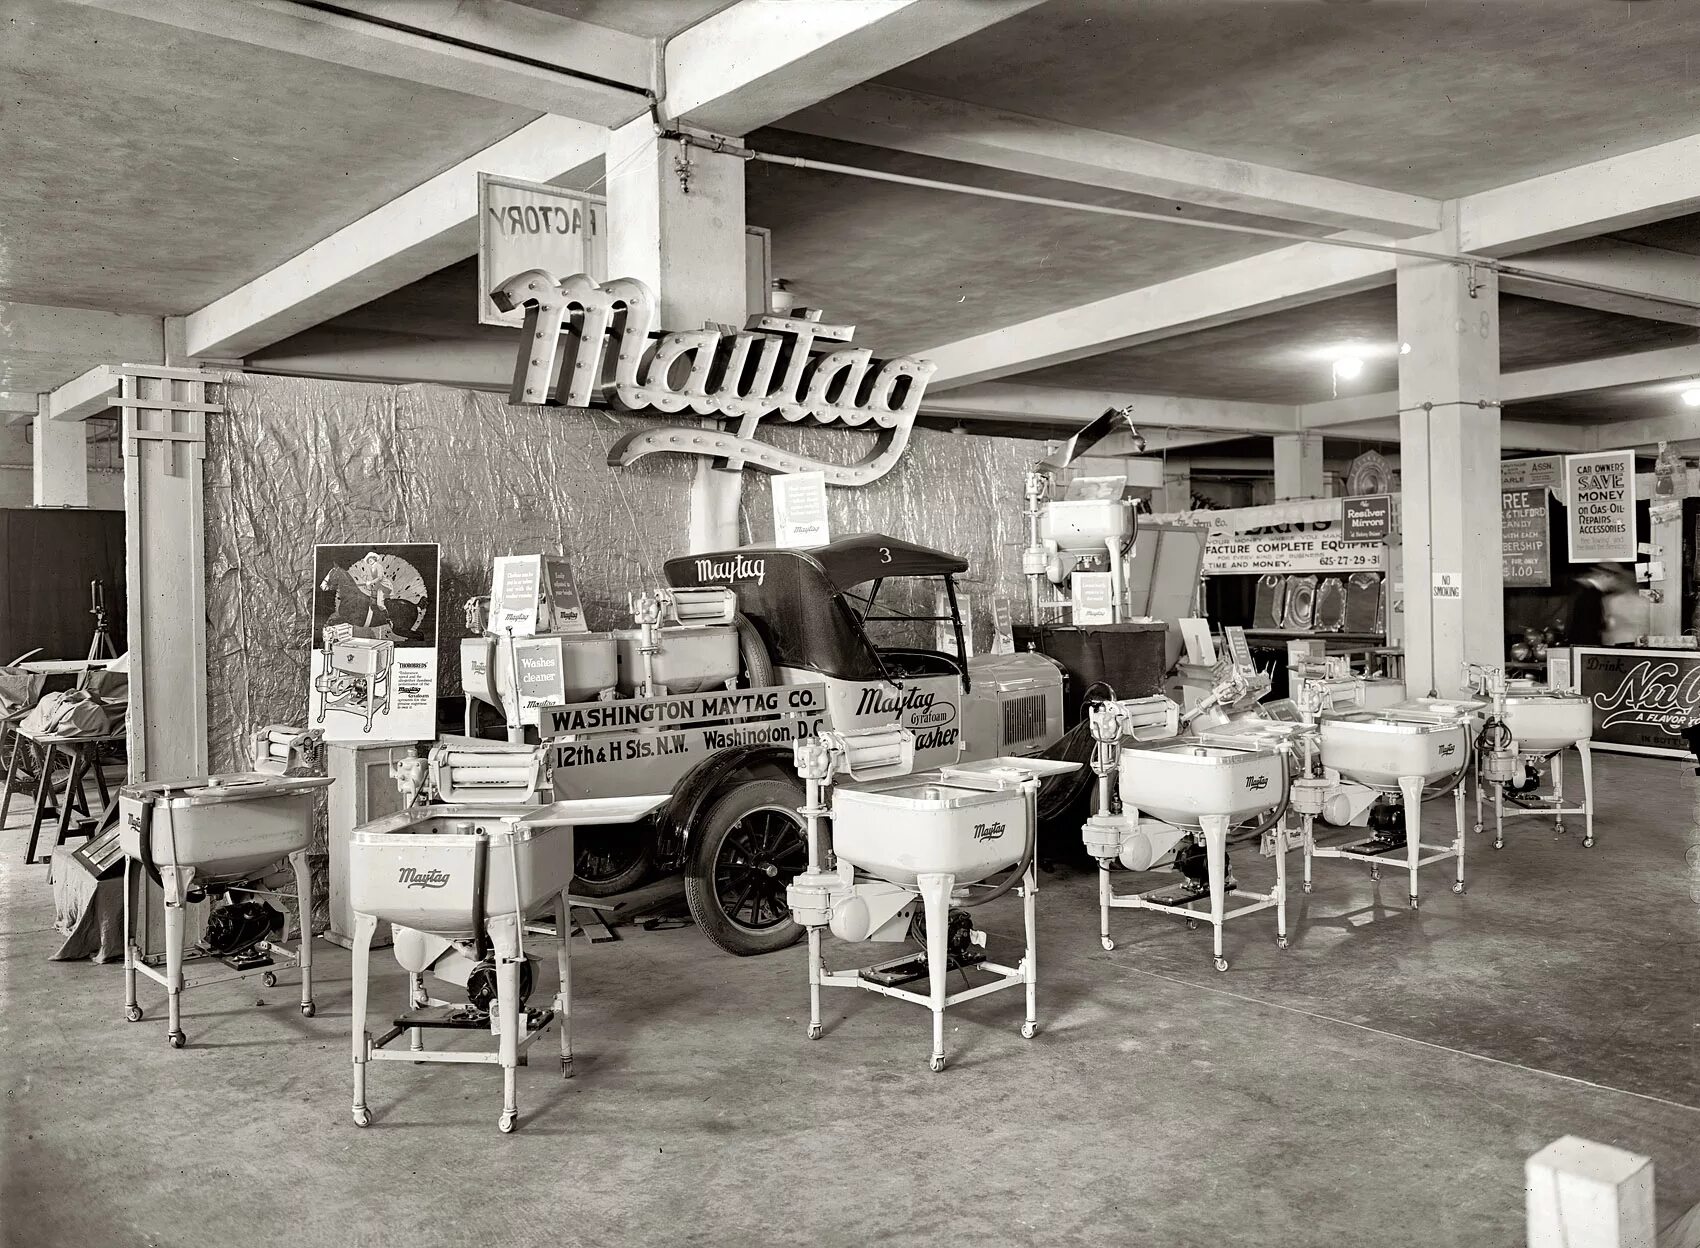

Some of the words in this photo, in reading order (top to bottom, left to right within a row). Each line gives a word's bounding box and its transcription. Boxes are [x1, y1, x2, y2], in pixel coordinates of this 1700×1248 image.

[490, 268, 938, 486] Maytag
[1577, 466, 1592, 474] CAR
[1594, 463, 1624, 473] OWNERS
[1578, 474, 1624, 490] SAVE
[1578, 490, 1624, 501] MONEY
[1347, 509, 1386, 518] Resilver
[1513, 508, 1546, 518] TILFORD
[1579, 515, 1611, 525] REPAIRS
[1351, 519, 1384, 527] Mirrors
[1579, 524, 1626, 534] ACCESSORIES
[1205, 544, 1250, 554] FACTURE
[1256, 541, 1314, 553] COMPLETE
[879, 547, 893, 564] 3
[694, 554, 765, 586] Maytag
[1441, 575, 1450, 585] NO
[1433, 586, 1459, 597] SMOKING
[521, 657, 555, 669] Washes
[1586, 657, 1626, 673] Drink
[523, 672, 556, 683] cleaner
[856, 686, 935, 720] Maytag
[552, 700, 694, 731] WASHINGTON
[701, 692, 778, 718] MAYTAG
[788, 690, 817, 707] CO.
[911, 711, 947, 725] Gyrafoam
[1646, 714, 1686, 724] FLAVOR
[911, 727, 959, 751] asher
[556, 745, 595, 769] 12th
[596, 747, 607, 763] &
[610, 741, 622, 761] H
[626, 739, 655, 759] Sts.
[656, 734, 689, 755] N.W.
[1438, 743, 1456, 757] Maytag
[1245, 775, 1268, 791] Maytag
[973, 822, 1006, 843] Maytag
[398, 867, 451, 889] Maytag
